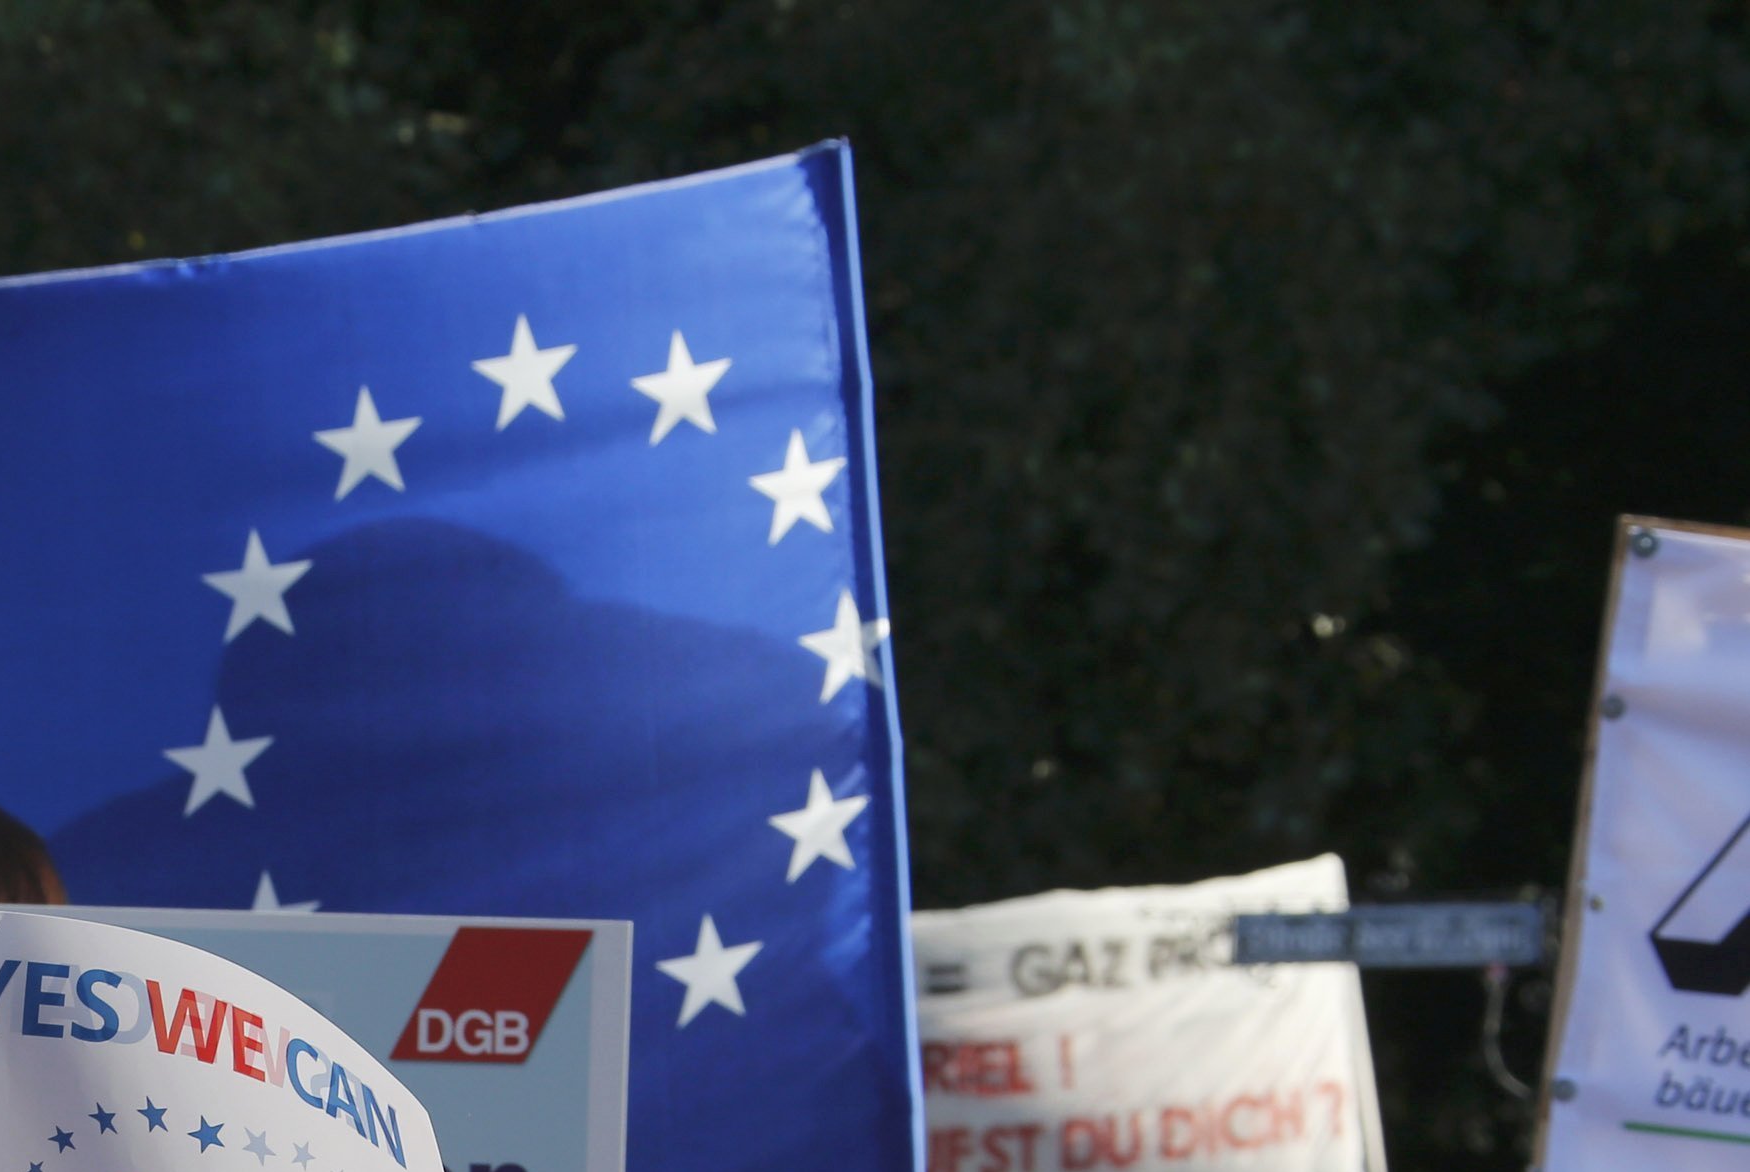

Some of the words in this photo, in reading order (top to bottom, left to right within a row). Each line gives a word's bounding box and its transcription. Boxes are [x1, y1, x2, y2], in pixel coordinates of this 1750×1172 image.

[1010, 936, 1130, 998] GAZ
[417, 1009, 530, 1055] DGB
[146, 979, 265, 1082] WE
[286, 1038, 407, 1169] CAN
[1159, 1092, 1304, 1162] DICH
